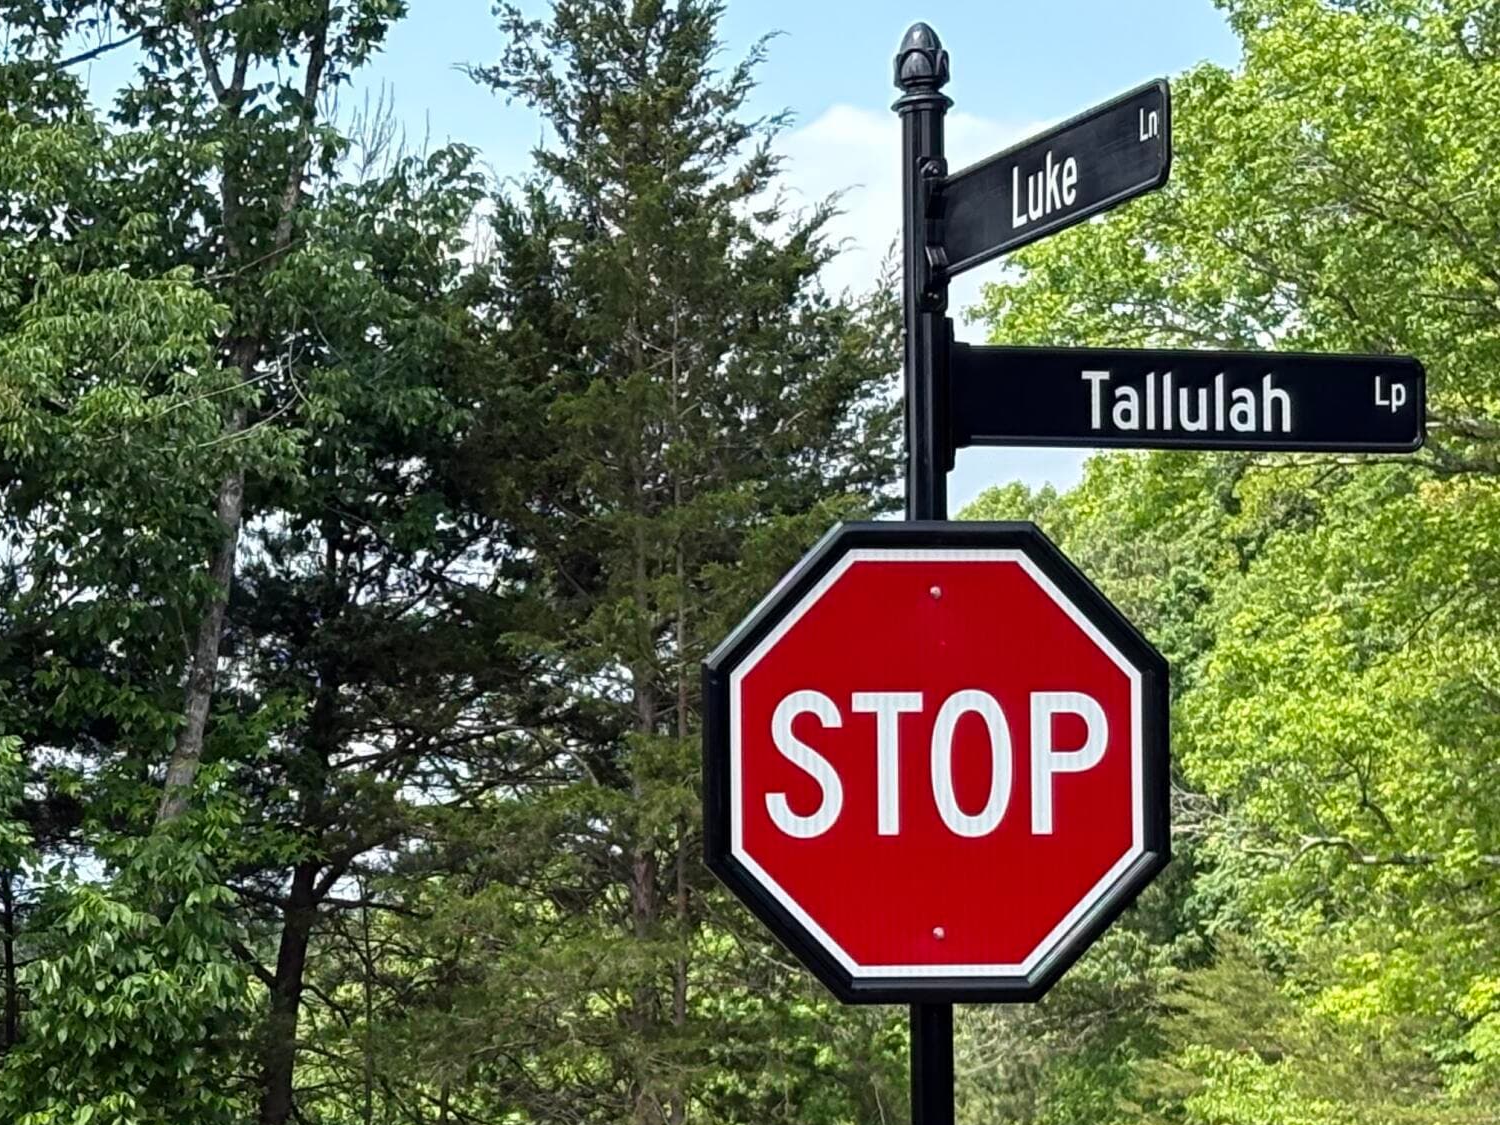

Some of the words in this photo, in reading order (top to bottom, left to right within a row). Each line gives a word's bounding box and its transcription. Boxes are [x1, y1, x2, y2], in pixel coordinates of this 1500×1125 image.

[1012, 150, 1078, 229] Luke
[1139, 107, 1158, 143] Ln
[1081, 371, 1292, 433] Tallulah
[1374, 375, 1407, 413] Lp
[764, 689, 1109, 839] STOP
